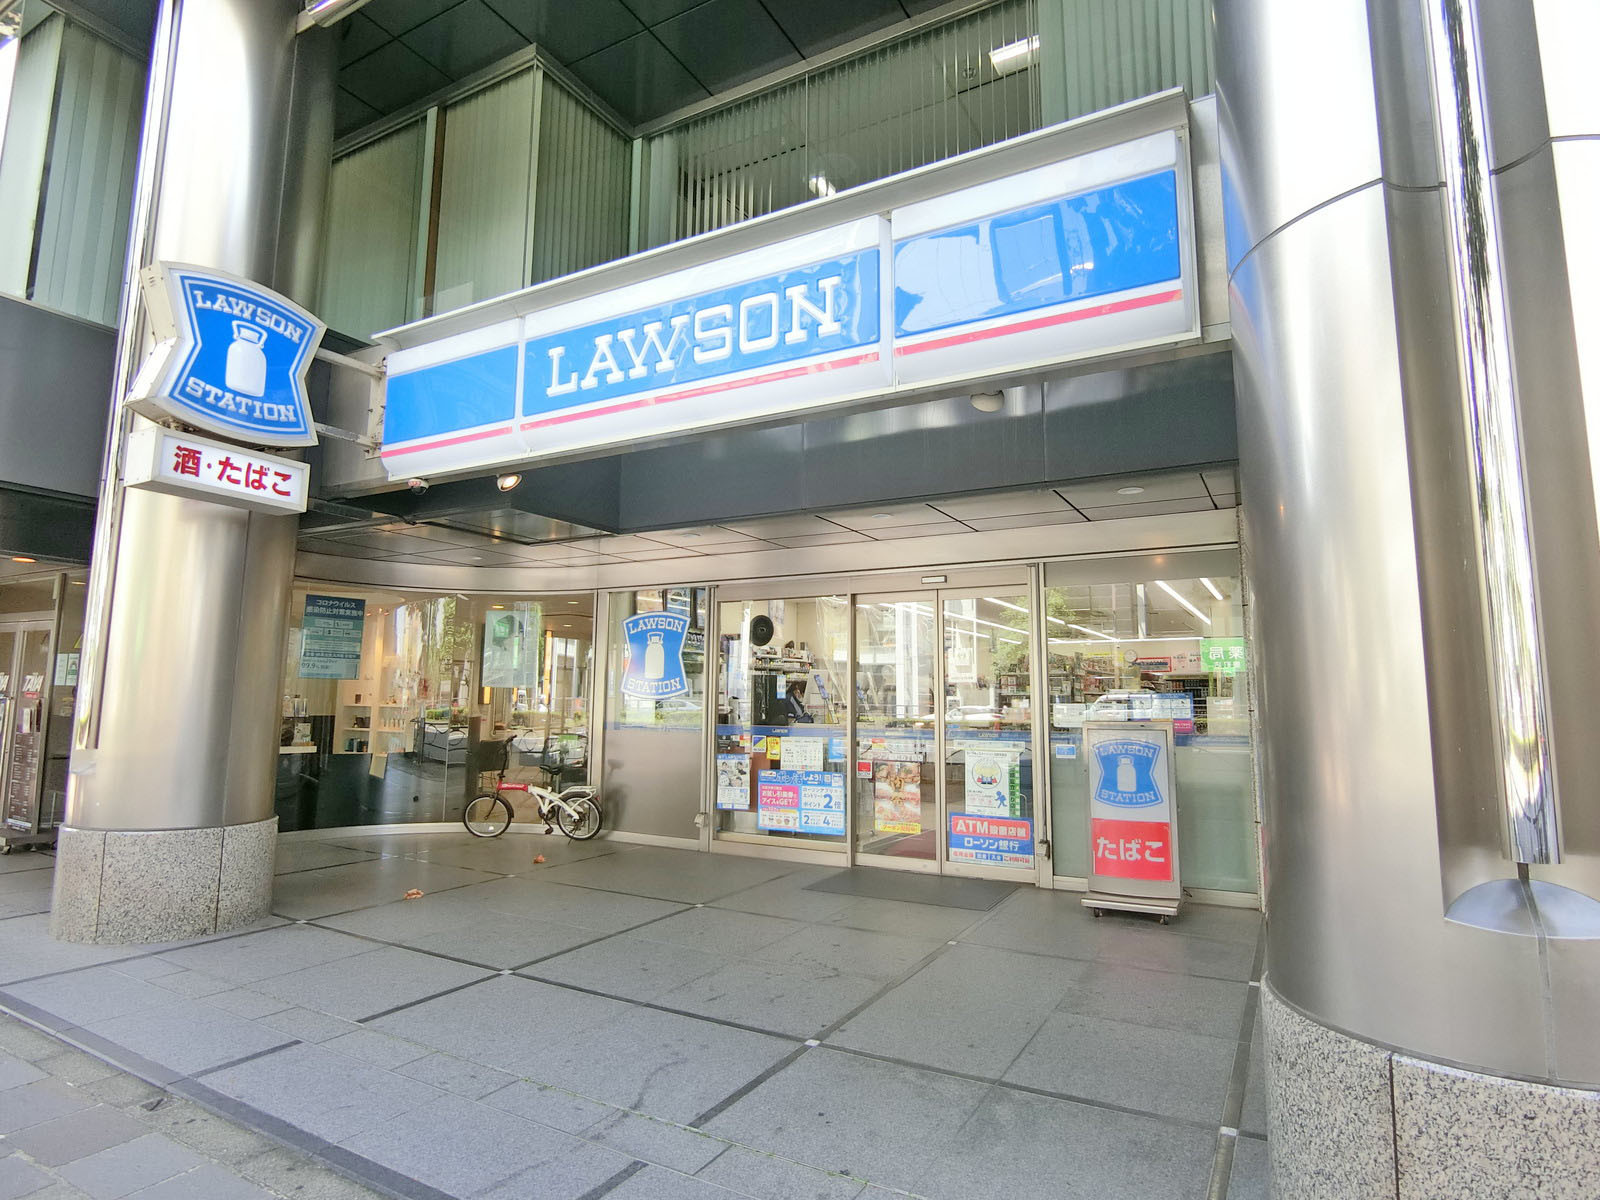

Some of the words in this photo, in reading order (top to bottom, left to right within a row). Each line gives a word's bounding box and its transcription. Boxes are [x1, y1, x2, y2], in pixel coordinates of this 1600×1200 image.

[193, 290, 303, 345] LAWSON
[546, 276, 841, 397] LAWSON
[185, 377, 297, 423] STATION
[172, 445, 292, 497] 酒・たばこ
[628, 617, 684, 634] LAWSON
[626, 676, 682, 692] STATION
[1099, 745, 1154, 758] LAWSON
[1100, 789, 1155, 802] STATION
[964, 837, 1020, 851] ローソン銀行
[1096, 836, 1165, 863] たばこ
